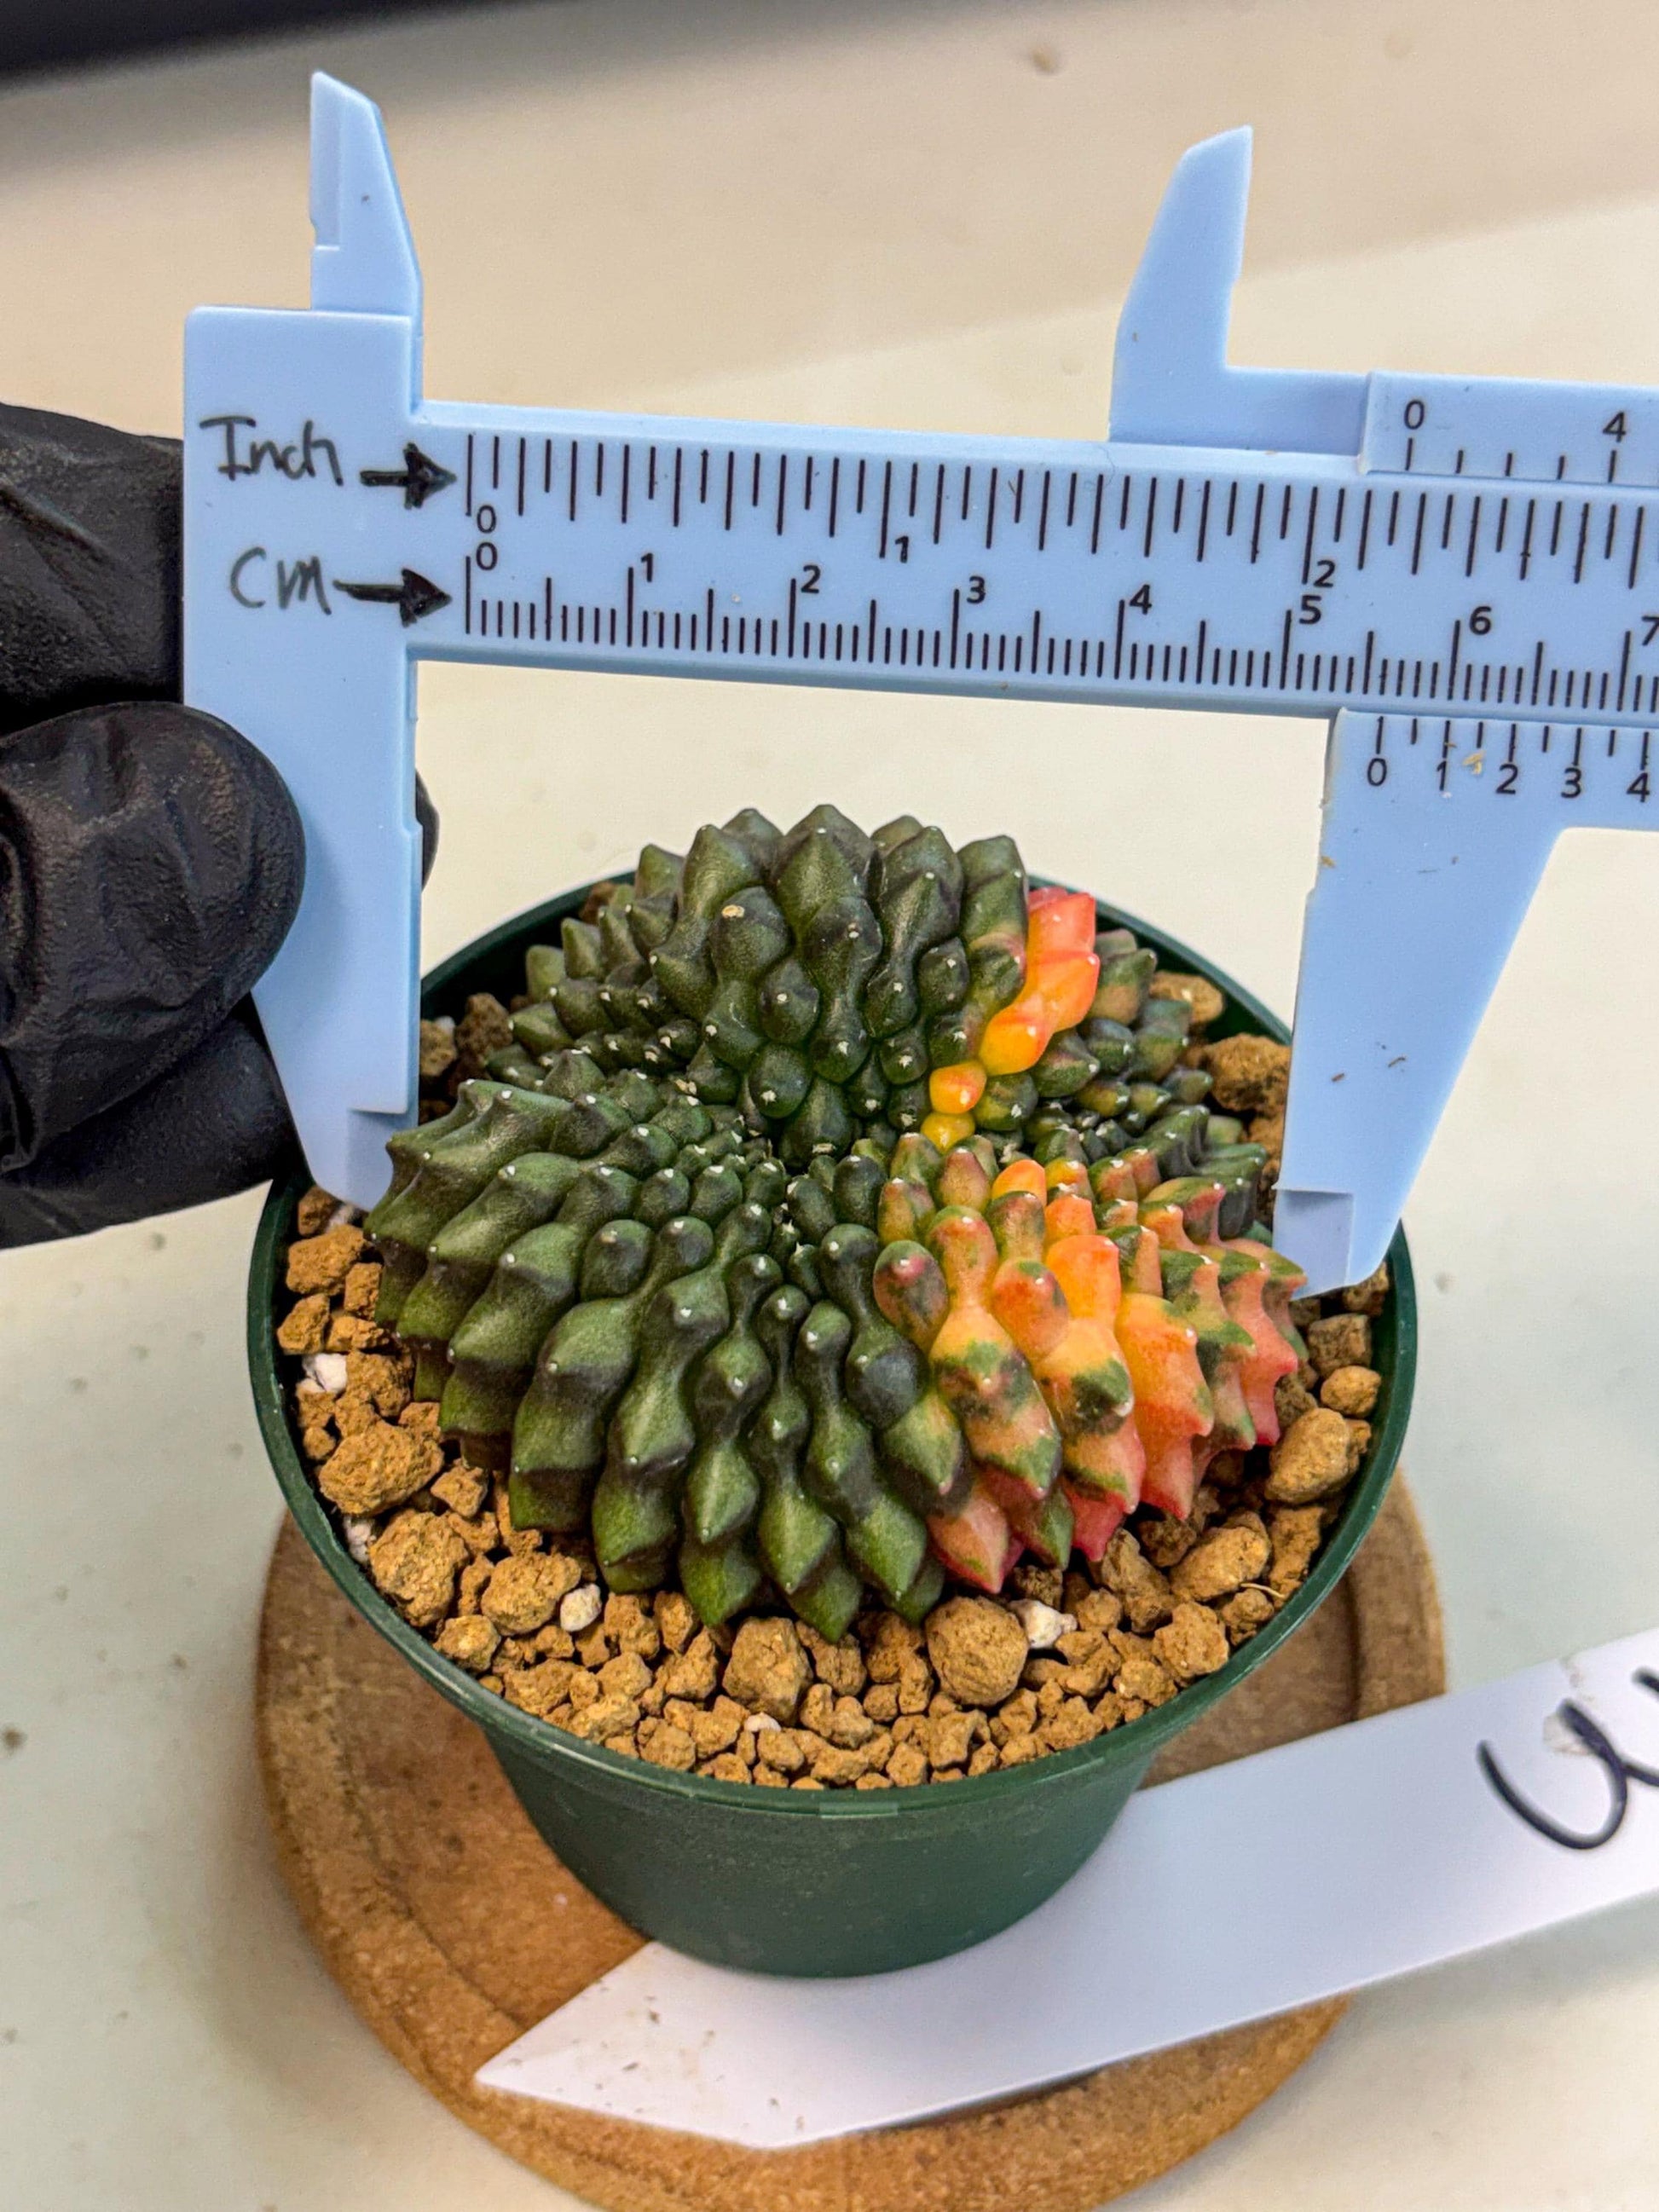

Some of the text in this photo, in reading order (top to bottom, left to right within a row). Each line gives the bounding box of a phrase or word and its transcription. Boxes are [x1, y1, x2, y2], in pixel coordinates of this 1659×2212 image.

[199, 415, 344, 487] Inch
[1402, 399, 1627, 442] 0 4
[476, 504, 1337, 588] 0 1 2
[475, 541, 1659, 647] 0 1 2 3 4 5 6 7
[1366, 757, 1651, 804] 0 1 2 3 4
